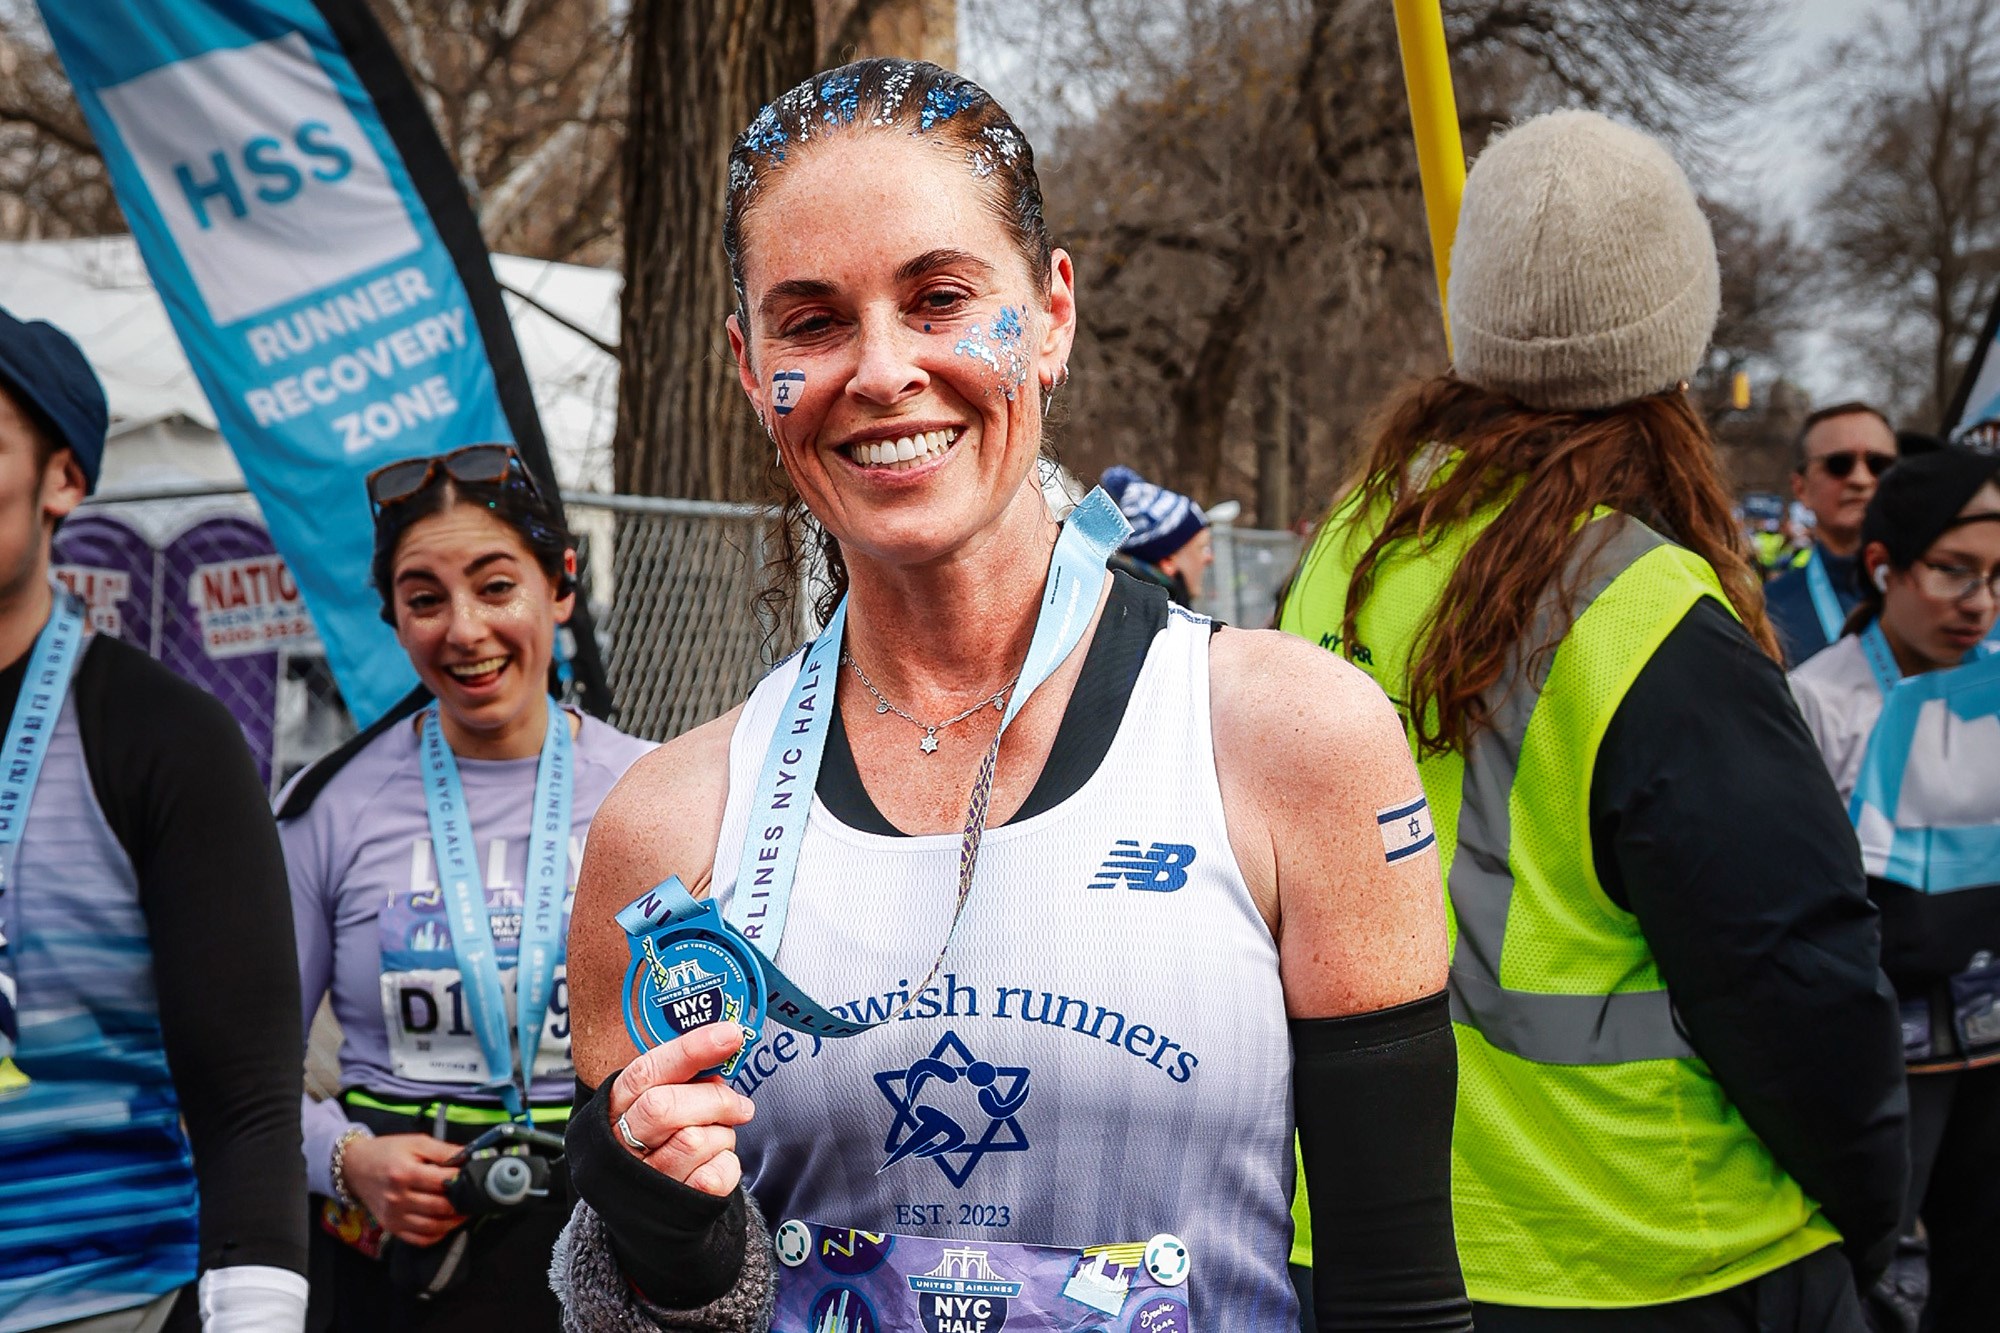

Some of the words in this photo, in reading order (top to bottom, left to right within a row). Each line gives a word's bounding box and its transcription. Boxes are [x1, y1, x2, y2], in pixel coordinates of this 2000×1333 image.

[174, 120, 353, 231] HSS
[246, 266, 435, 366] RUNNER
[244, 306, 468, 428] RECOVERY
[331, 375, 460, 455] ZONE
[436, 777, 454, 812] NYC
[544, 753, 563, 832] AIRLINES
[744, 825, 785, 939] RLINES
[771, 748, 802, 810] NYC
[791, 660, 823, 735] HALF
[444, 820, 465, 867] HALF
[540, 841, 558, 878] NYC
[535, 885, 553, 934] HALF
[656, 989, 683, 1003] UNITED
[690, 977, 722, 992] AIRLINES
[673, 993, 712, 1019] NYC
[680, 1008, 713, 1029] HALF
[992, 986, 1200, 1085] runners
[894, 1203, 952, 1227] EST.
[958, 1203, 1011, 1228] 2023
[916, 1280, 953, 1290] UNITED
[965, 1284, 1014, 1293] AIRLINES
[935, 1296, 992, 1320] NYC
[938, 1319, 987, 1333] HALF
